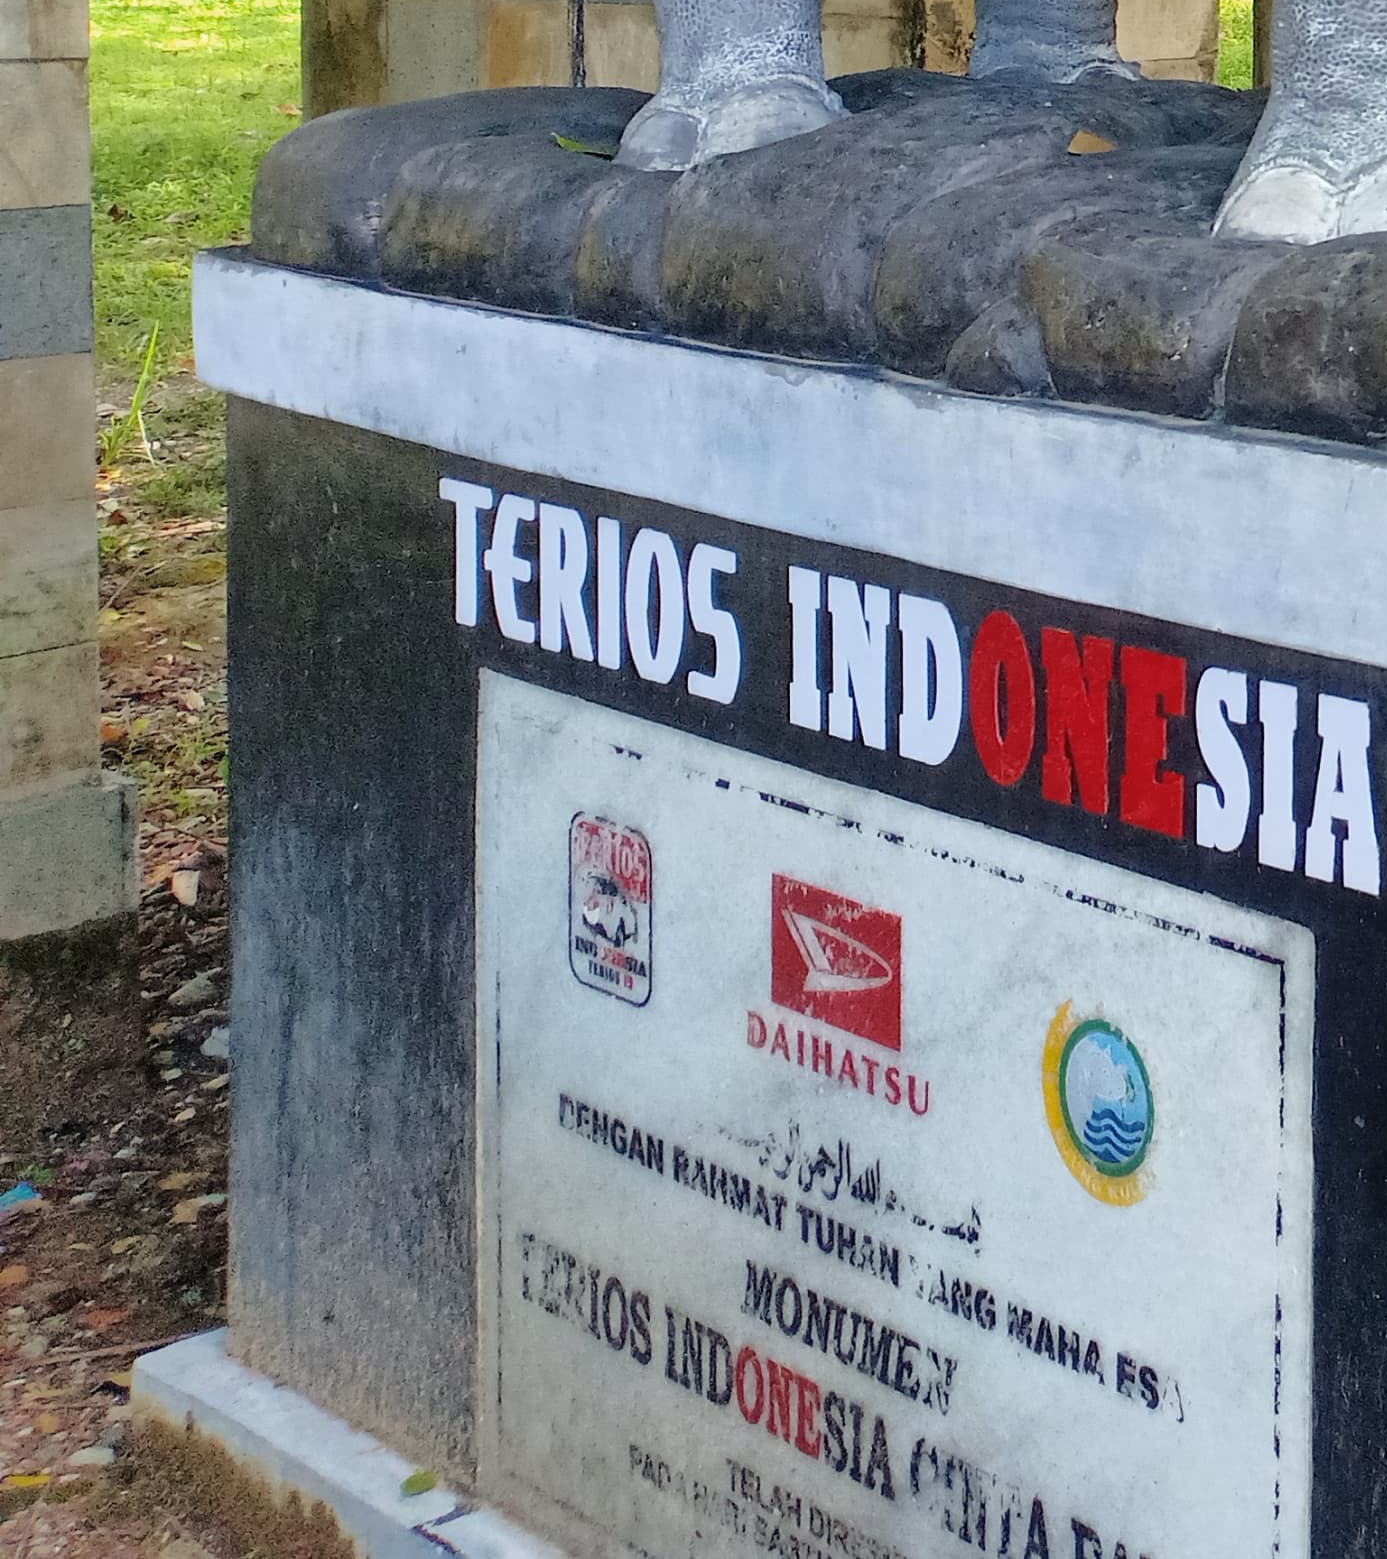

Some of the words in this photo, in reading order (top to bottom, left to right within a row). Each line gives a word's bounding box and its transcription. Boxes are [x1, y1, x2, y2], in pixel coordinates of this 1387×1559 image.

[438, 476, 741, 705] TERIOS
[787, 565, 1382, 897] INDONESIA
[574, 826, 647, 882] IOS
[746, 1009, 930, 1116] DAIHATSU
[672, 1144, 788, 1231] RAHMAT
[795, 1203, 899, 1288] TUHAN
[908, 1253, 997, 1332] ANG
[1007, 1300, 1106, 1386] MAHA
[740, 1259, 959, 1417] MONUMEN
[664, 1303, 896, 1501] INDONESIA
